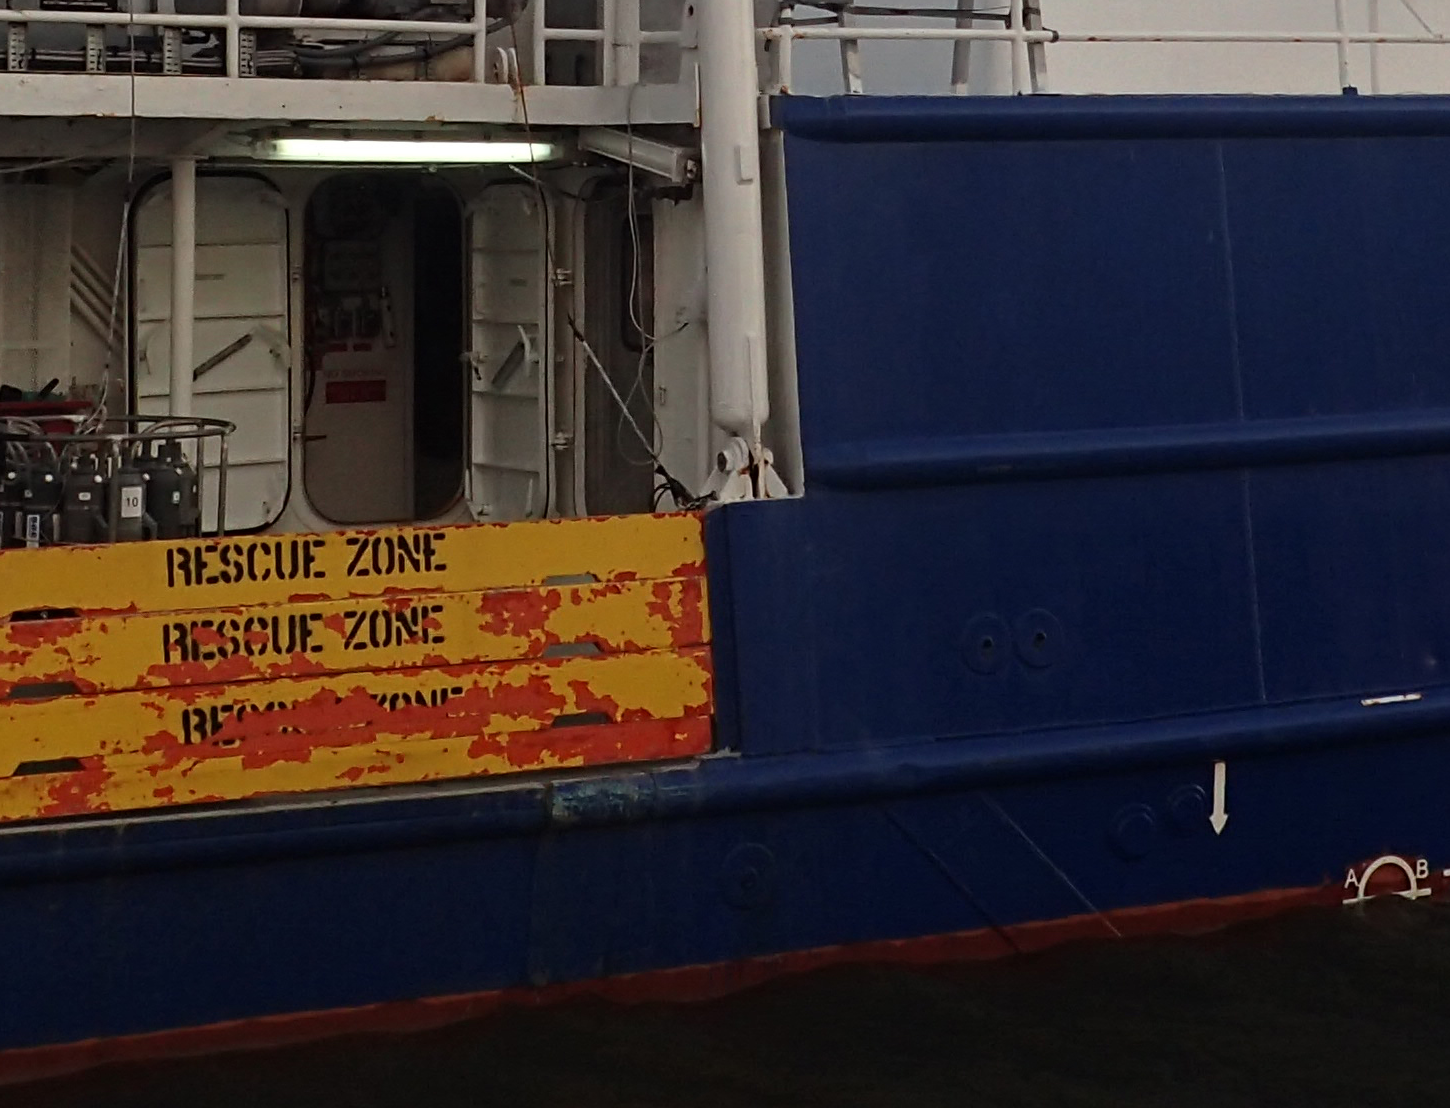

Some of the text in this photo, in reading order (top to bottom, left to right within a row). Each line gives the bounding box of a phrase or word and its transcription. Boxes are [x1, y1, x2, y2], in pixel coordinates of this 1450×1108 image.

[125, 496, 139, 508] 10
[165, 532, 448, 588] RESCUE ZONE
[162, 604, 445, 664] RESCUE ZONE
[1344, 859, 1429, 889] A B
